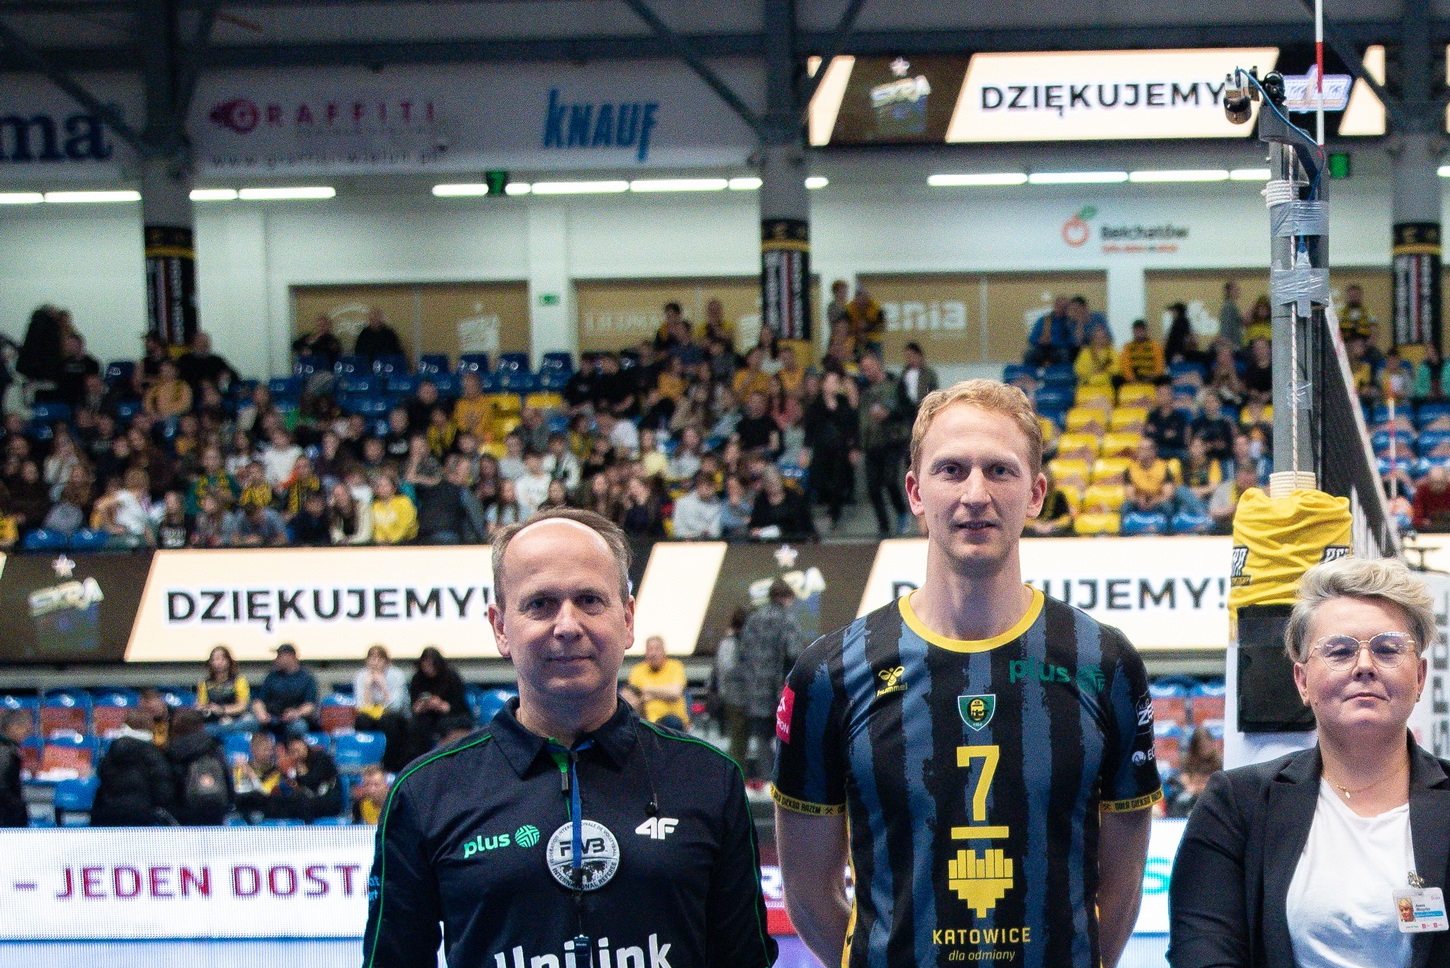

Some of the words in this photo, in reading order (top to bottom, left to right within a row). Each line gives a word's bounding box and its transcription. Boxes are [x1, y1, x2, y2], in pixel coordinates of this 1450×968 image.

[981, 82, 1226, 117] DZIĘKUJEMY
[0, 114, 112, 162] ma
[543, 89, 660, 161] KNAUF
[1009, 657, 1071, 686] plus
[956, 745, 1000, 821] 7
[635, 817, 679, 840] 4F
[464, 831, 510, 859] plus
[559, 838, 606, 857] FVB
[56, 863, 211, 899] JEDEN
[234, 863, 368, 899] DOST
[932, 927, 1032, 945] KATOWICE
[948, 948, 965, 961] dla
[968, 948, 1016, 962] odmiany
